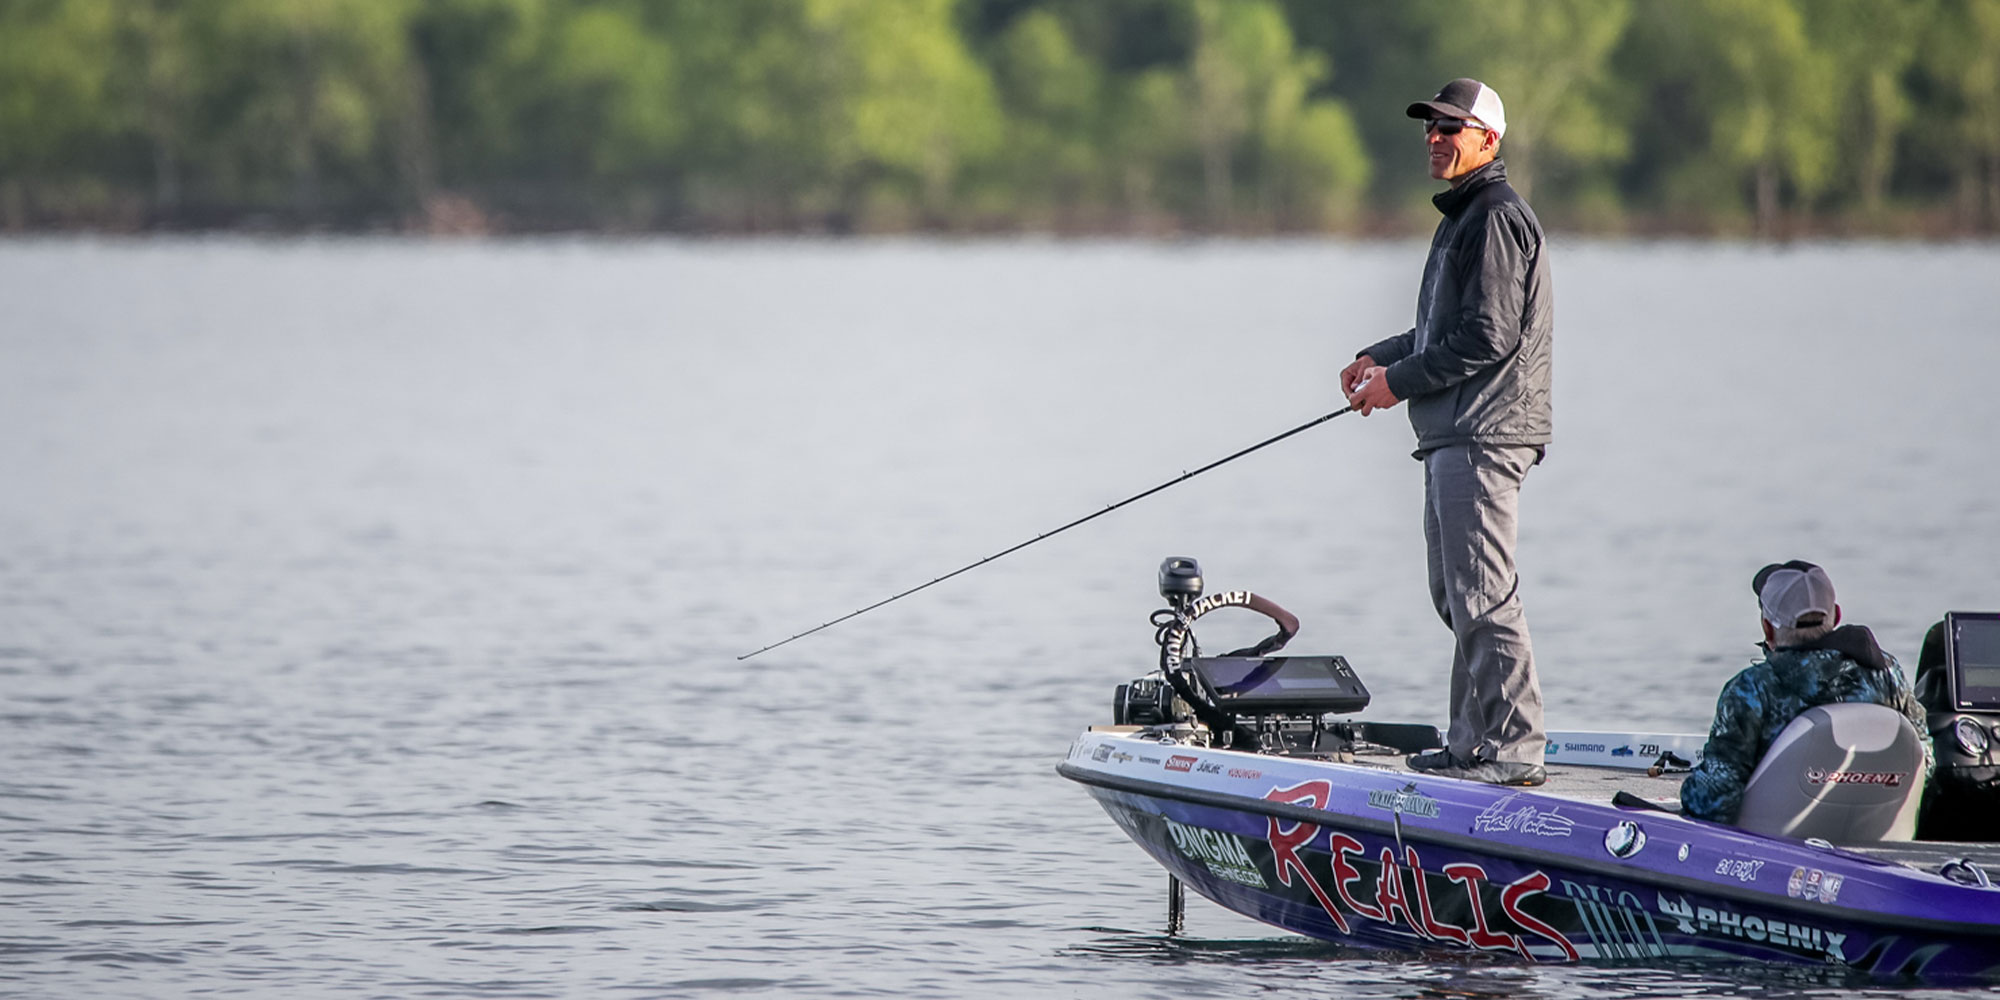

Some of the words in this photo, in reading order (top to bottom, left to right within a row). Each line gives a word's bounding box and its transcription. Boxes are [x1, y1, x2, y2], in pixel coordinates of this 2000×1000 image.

[1193, 591, 1252, 617] JACKET
[1565, 743, 1605, 752] SHIMANO
[1825, 772, 1907, 785] PHOENIX
[1264, 779, 1581, 962] REALIS
[1730, 860, 1764, 881] PHX
[1560, 879, 1670, 959] DUO
[1697, 906, 1847, 960] PHOENIX
